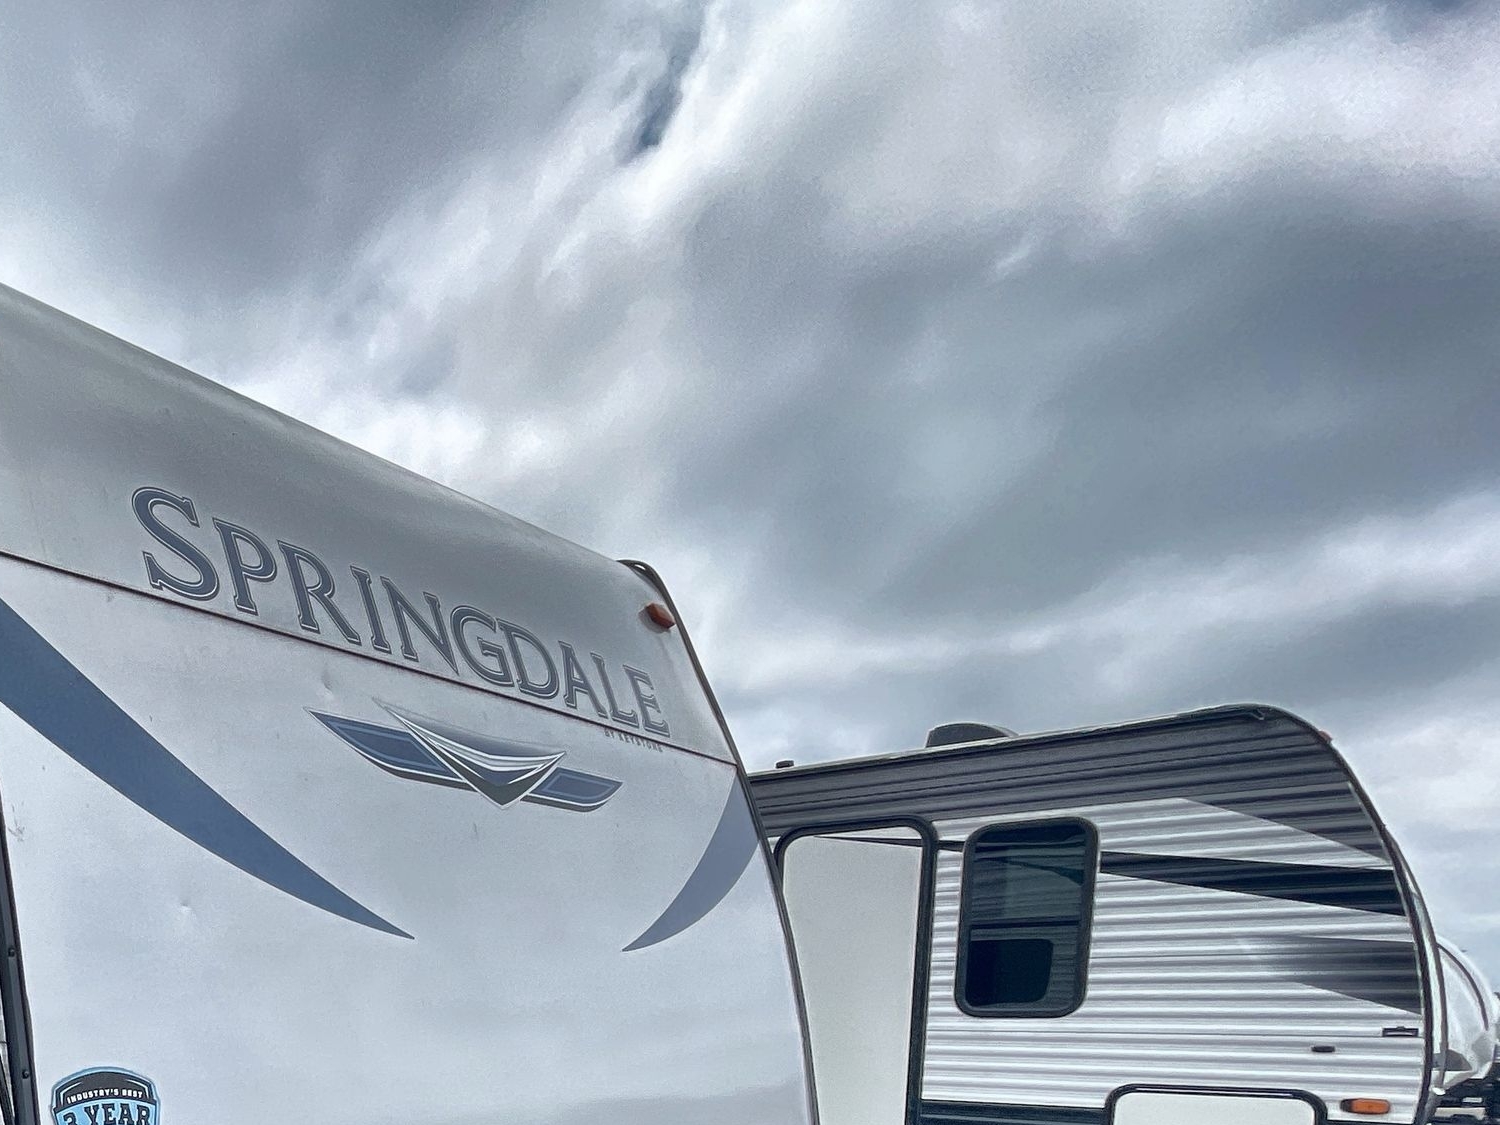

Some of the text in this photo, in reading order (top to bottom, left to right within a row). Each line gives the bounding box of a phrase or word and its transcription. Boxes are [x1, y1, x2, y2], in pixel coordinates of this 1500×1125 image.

[131, 486, 670, 738] SPRINGDALE
[67, 1088, 143, 1104] INDUSTRY'S BEST
